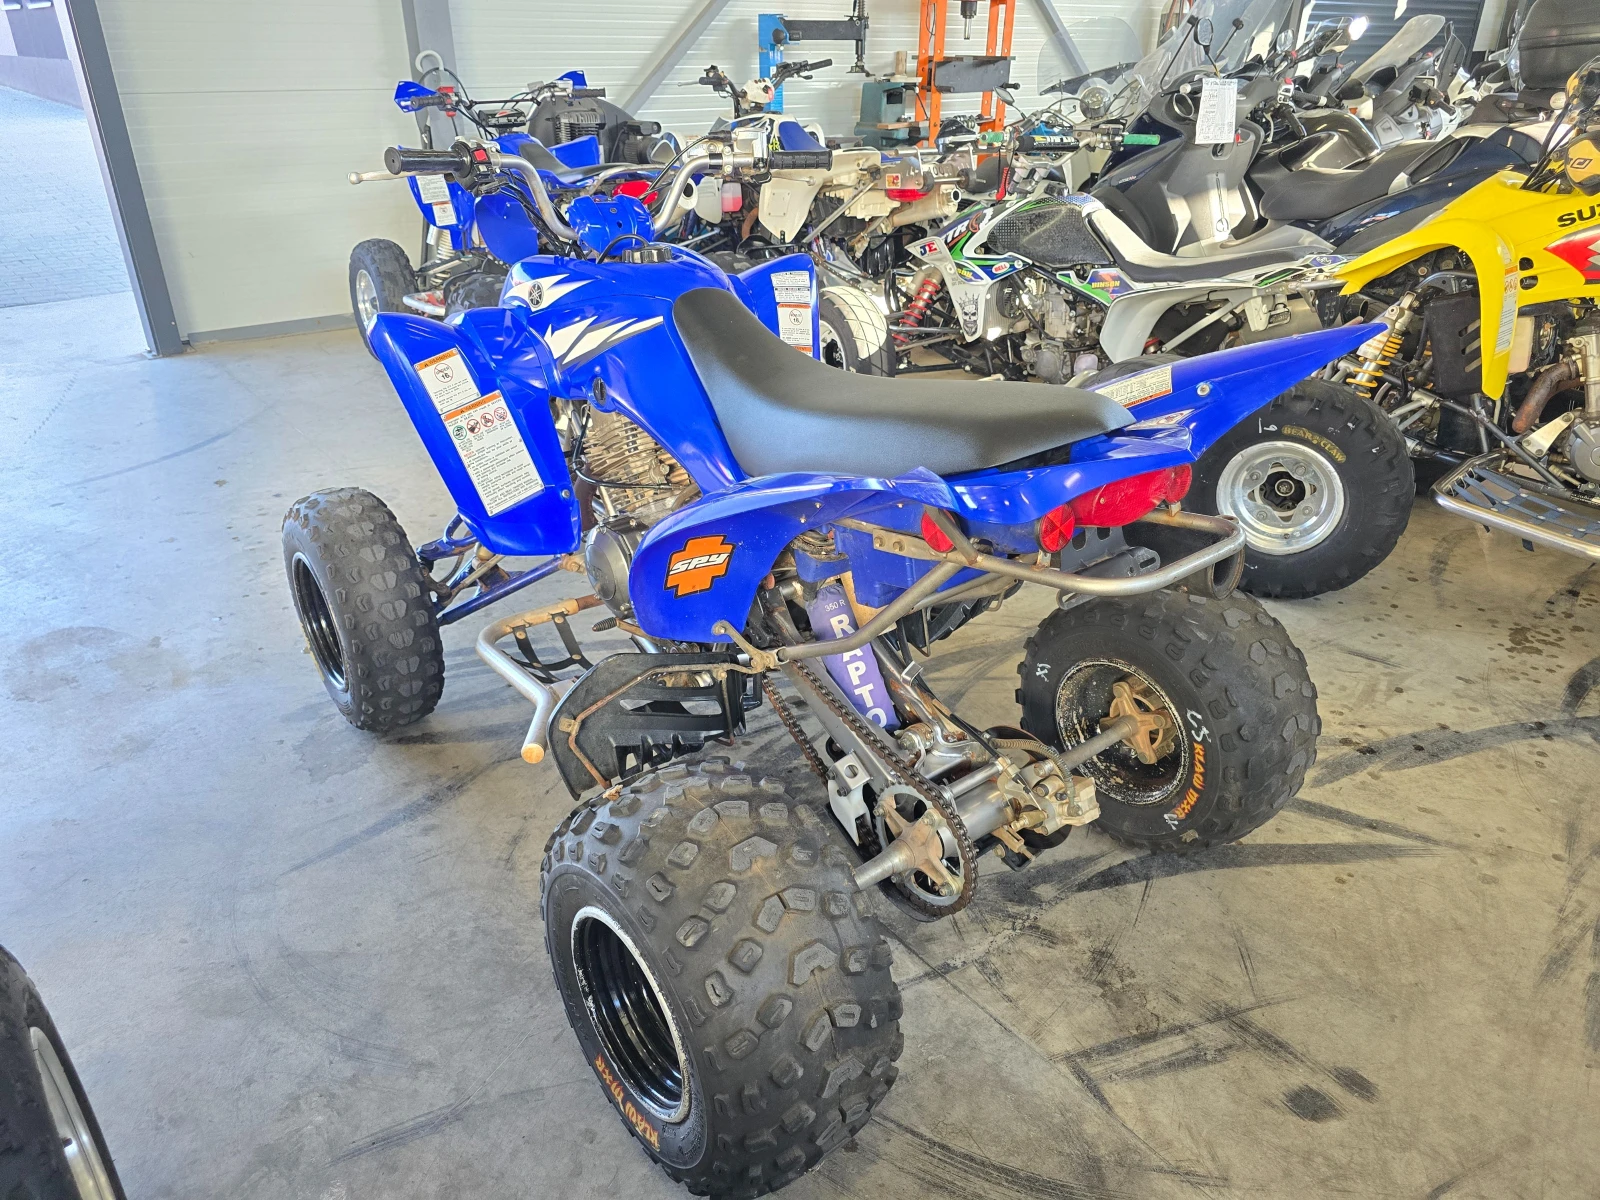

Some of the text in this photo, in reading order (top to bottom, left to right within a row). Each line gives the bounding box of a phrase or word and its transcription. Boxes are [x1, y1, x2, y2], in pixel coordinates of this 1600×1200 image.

[1557, 204, 1600, 227] SU
[919, 242, 938, 257] JE
[994, 264, 1008, 273] BELL
[1284, 426, 1344, 462] BEAR CLAW
[669, 553, 730, 575] SPY
[824, 598, 846, 612] 350 R
